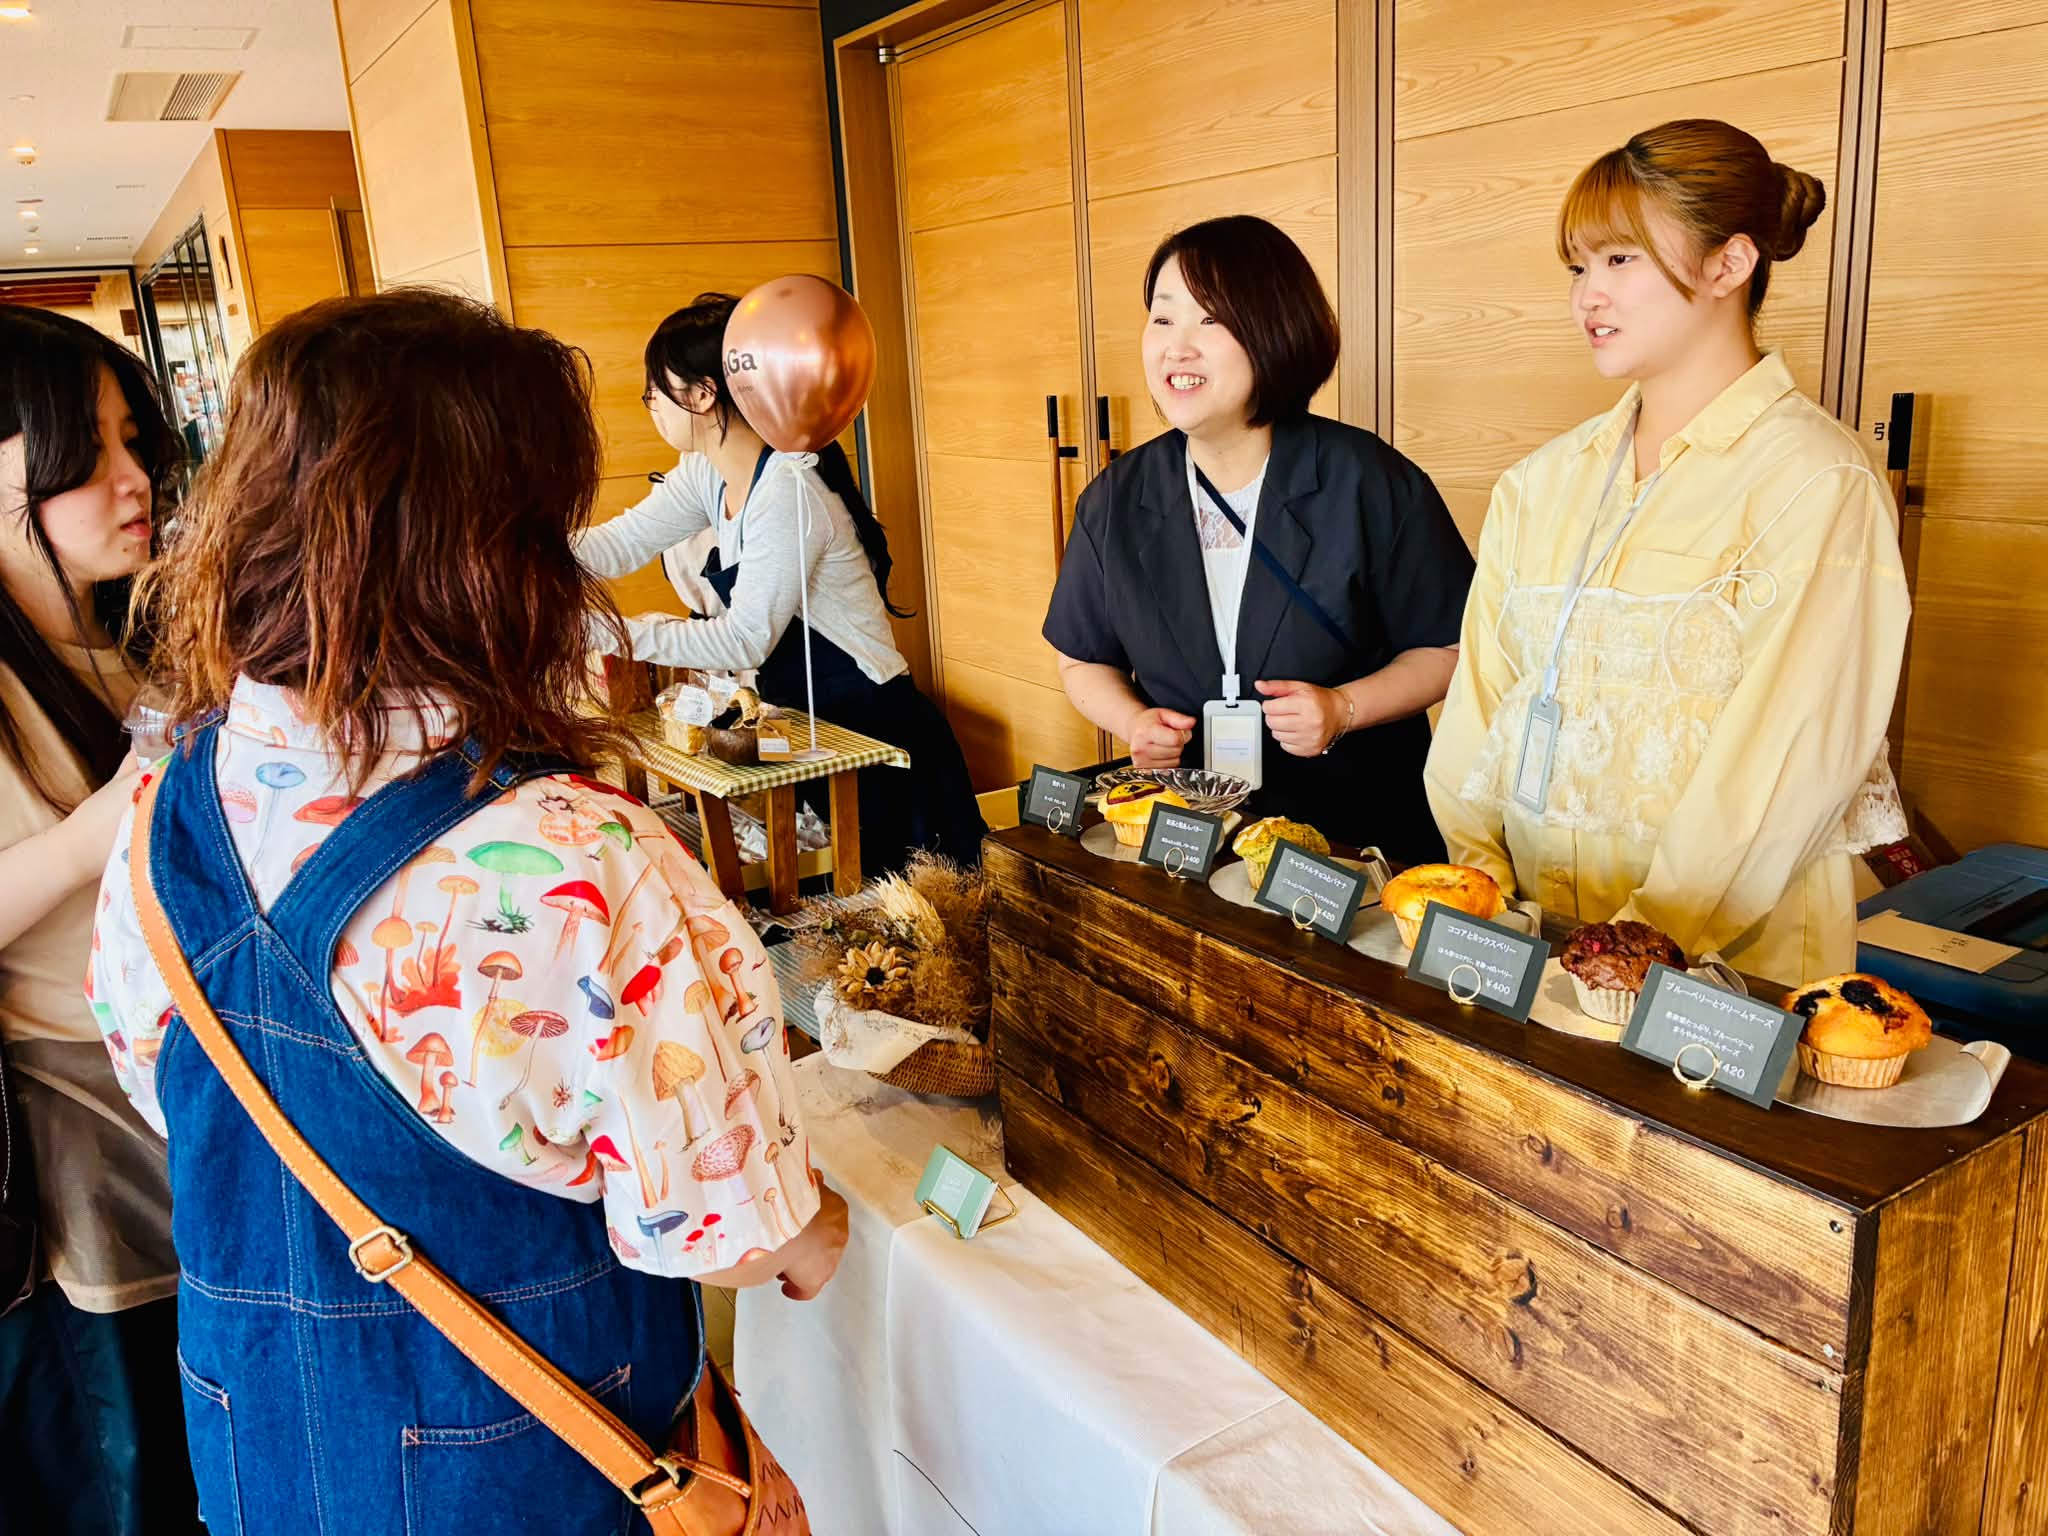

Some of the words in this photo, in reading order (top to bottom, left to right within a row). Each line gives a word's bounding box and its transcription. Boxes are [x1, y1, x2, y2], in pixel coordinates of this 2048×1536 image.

[1447, 925, 1518, 954] ココアとミックスベリー
[1486, 979, 1511, 996] ¥400
[1664, 980, 1775, 1029] ブルーベリーとクリームチーズ
